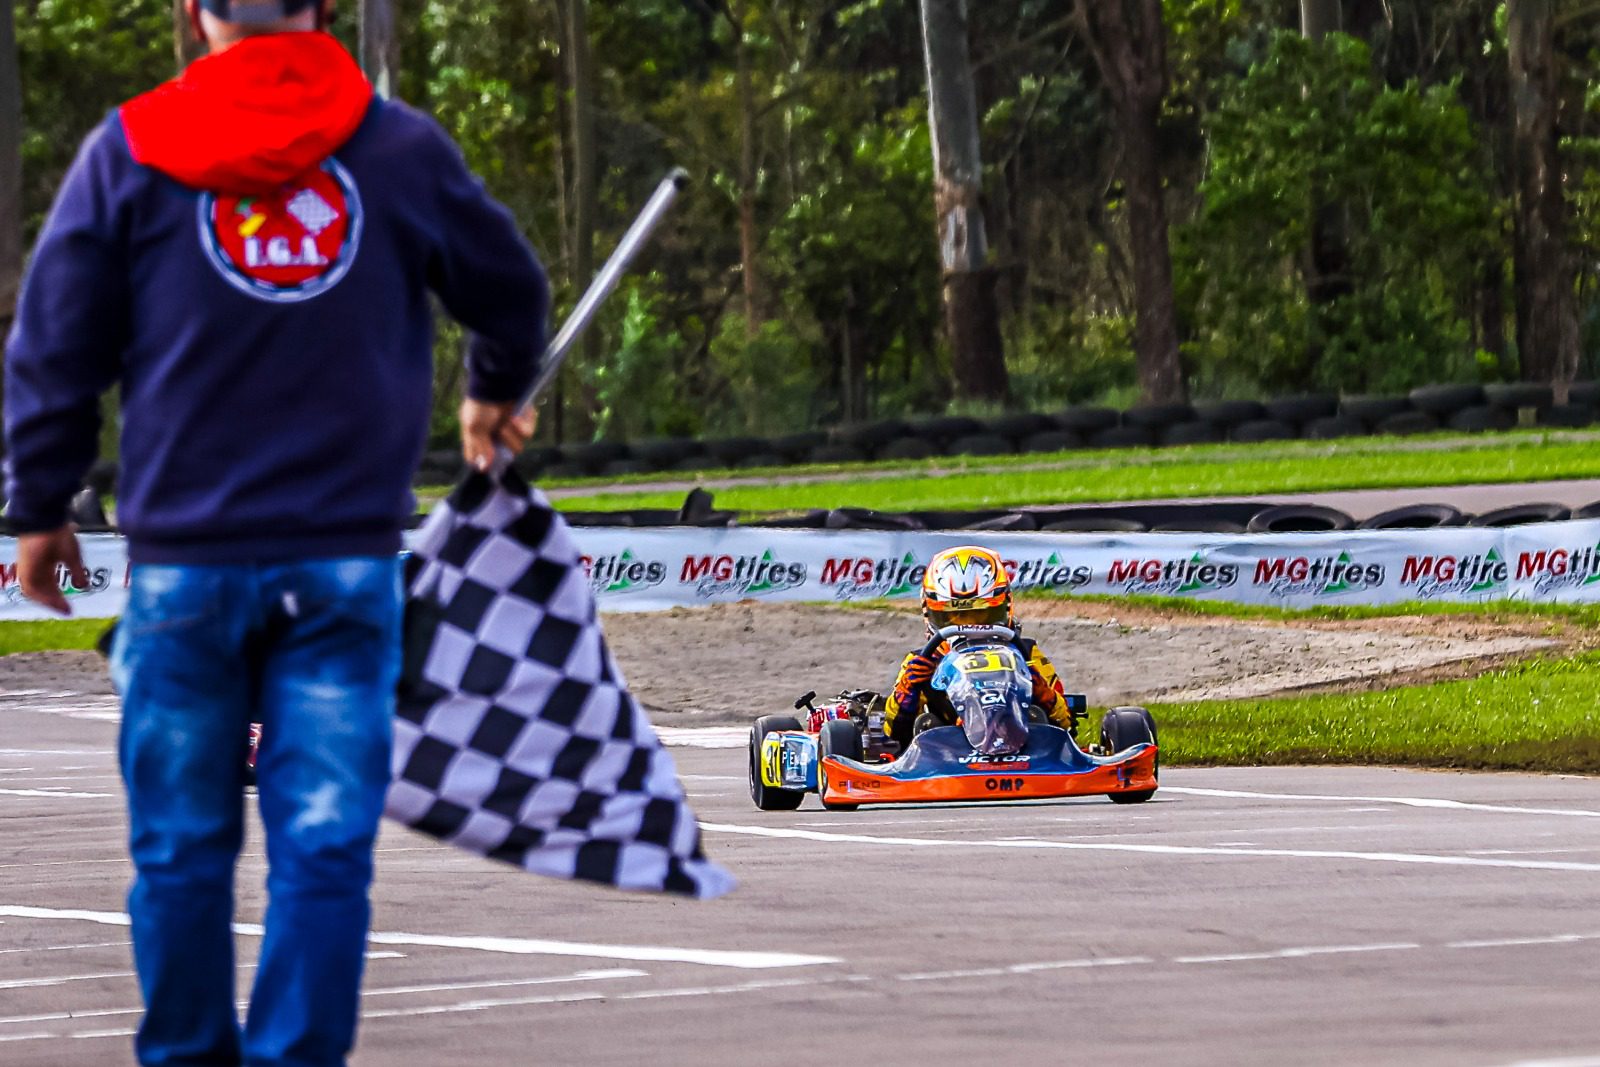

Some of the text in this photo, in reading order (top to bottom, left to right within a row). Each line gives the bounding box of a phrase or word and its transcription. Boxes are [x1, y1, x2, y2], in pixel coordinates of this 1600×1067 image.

[680, 555, 802, 583] MGtires
[820, 558, 927, 585] MGtire
[1107, 560, 1235, 584] MGtires
[1253, 557, 1381, 584] MGtires
[1400, 555, 1508, 584] MGtire
[958, 755, 1031, 764] VICTOR
[985, 778, 1024, 791] OMP
